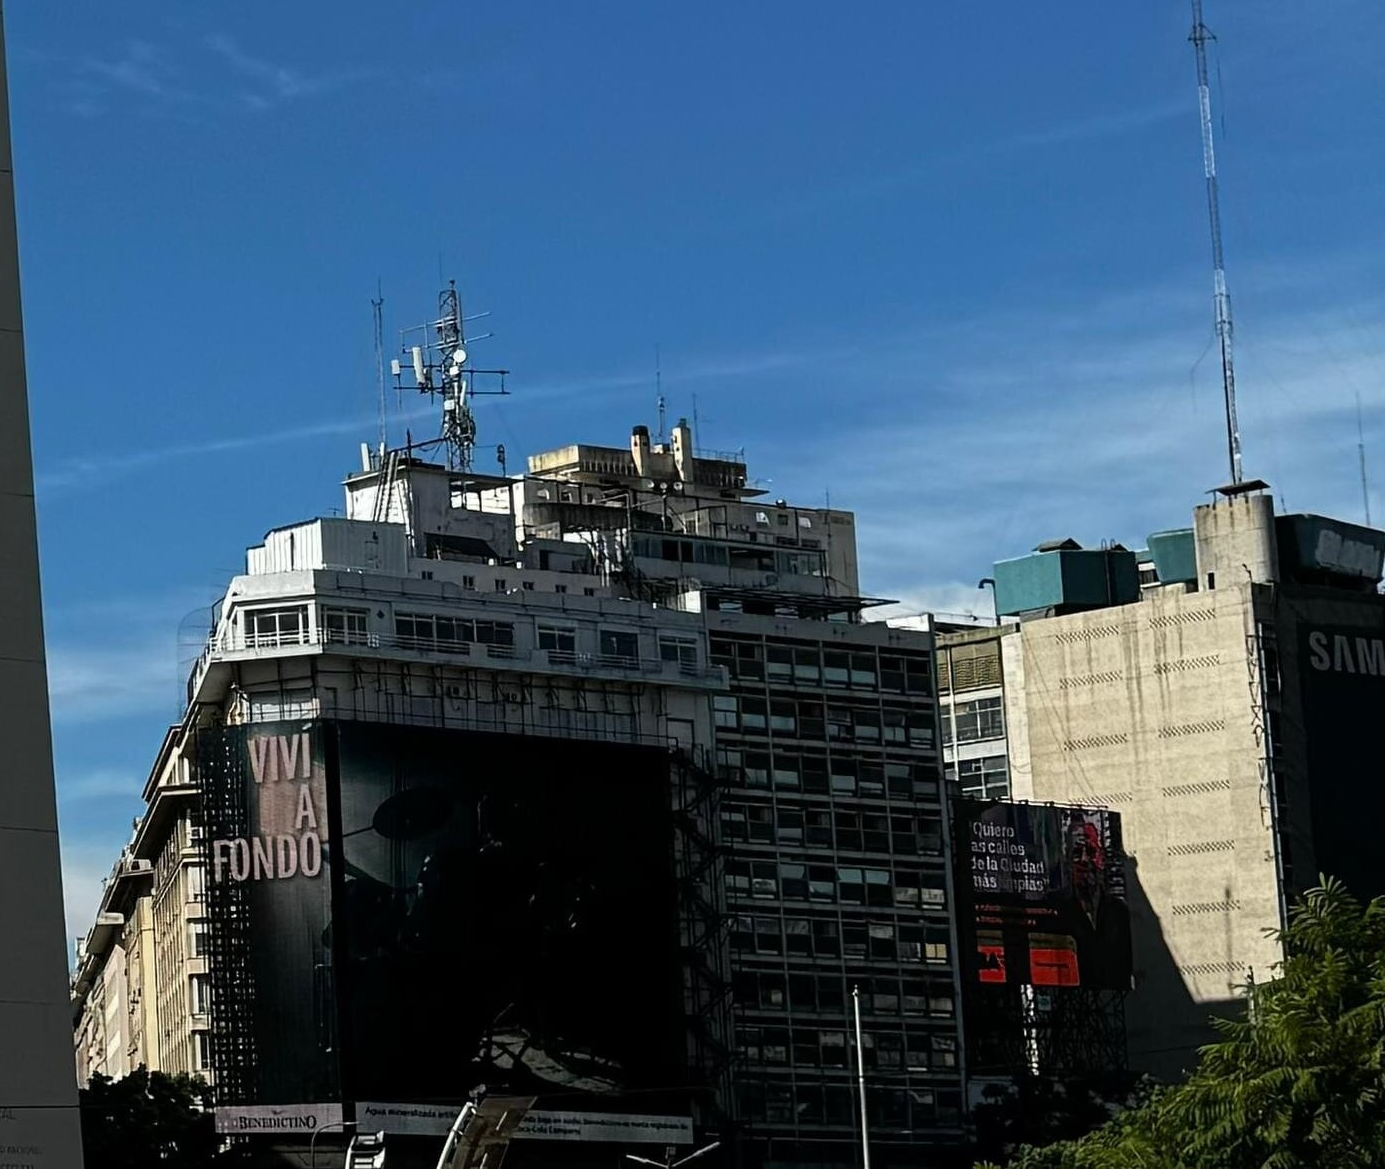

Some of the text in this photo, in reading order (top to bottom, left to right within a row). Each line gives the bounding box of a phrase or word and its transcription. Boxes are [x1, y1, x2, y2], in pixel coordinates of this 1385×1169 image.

[247, 732, 311, 784] VIVI
[294, 783, 318, 830] A
[213, 831, 322, 883] FONDO
[986, 856, 998, 871] la
